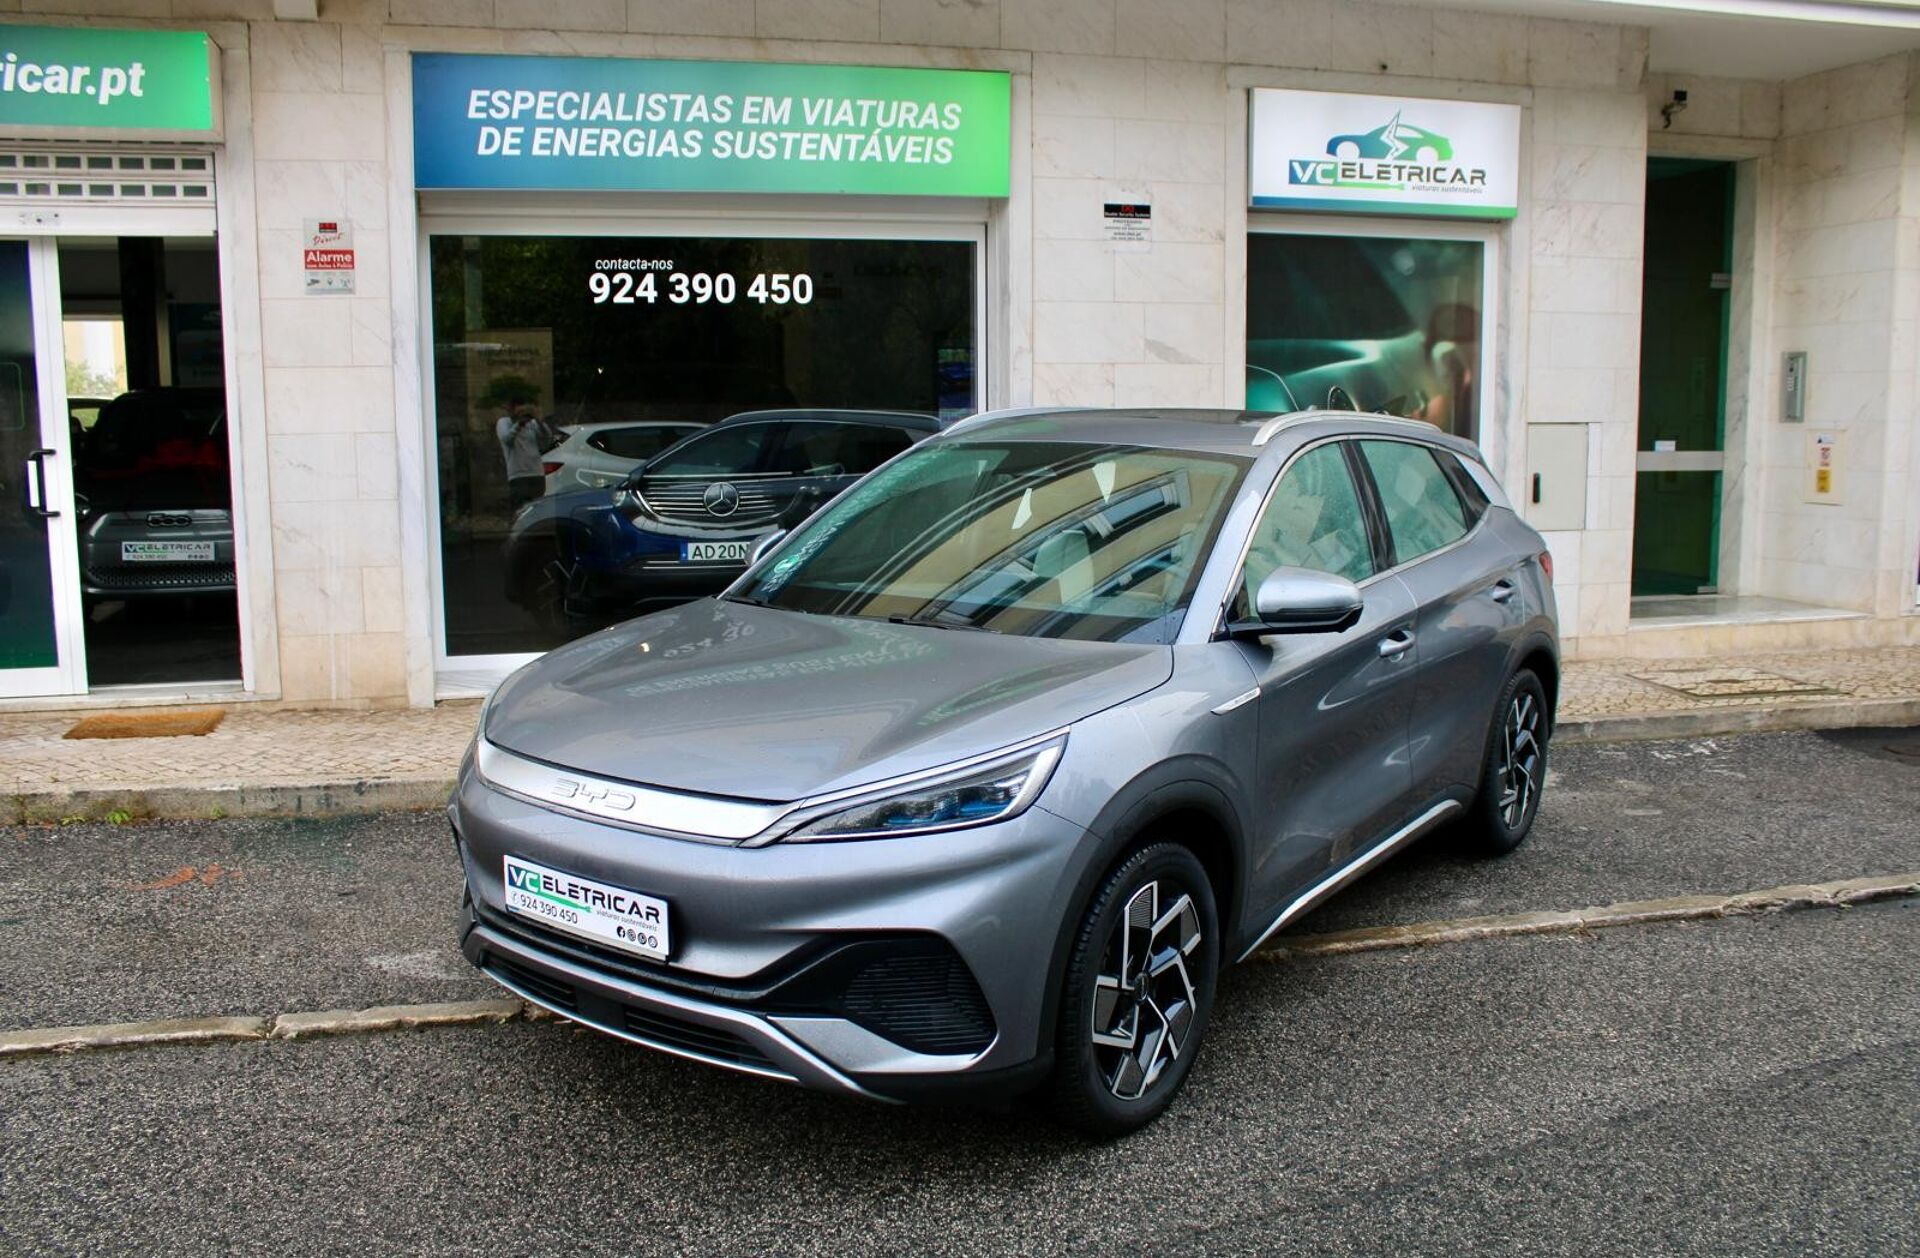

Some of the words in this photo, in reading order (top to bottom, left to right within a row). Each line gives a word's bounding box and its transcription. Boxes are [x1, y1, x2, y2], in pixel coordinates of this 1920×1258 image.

[0, 52, 145, 105] icar.pt
[467, 89, 734, 123] ESPECIALISTAS
[742, 95, 792, 125] EM
[802, 97, 962, 130] VIATURAS
[477, 126, 525, 156] DE
[532, 127, 704, 158] ENERGIAS
[711, 129, 954, 164] SUSTENTÁVEIS
[306, 250, 353, 262] Alarme
[595, 258, 674, 270] contacta-nos
[588, 272, 658, 304] 924
[668, 273, 736, 304] 390
[747, 273, 813, 304] 450
[551, 777, 637, 812] BYD
[519, 894, 539, 910] 924
[539, 899, 558, 918] 390
[559, 906, 579, 924] 450
